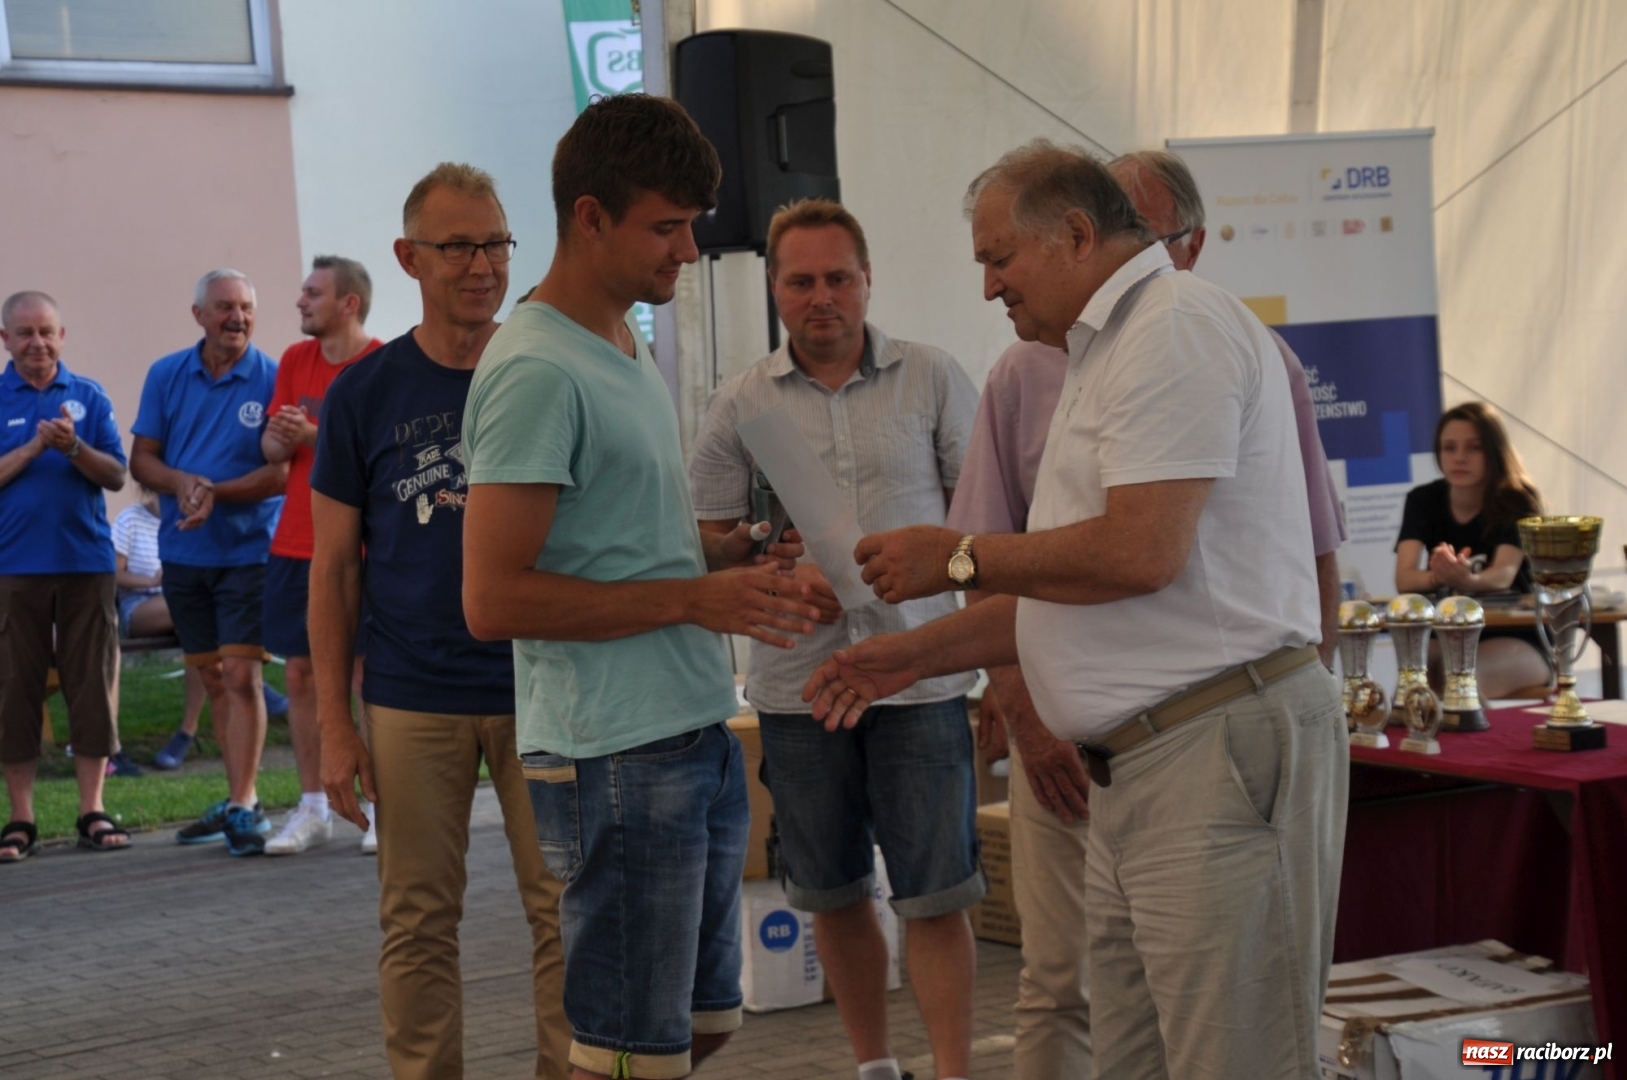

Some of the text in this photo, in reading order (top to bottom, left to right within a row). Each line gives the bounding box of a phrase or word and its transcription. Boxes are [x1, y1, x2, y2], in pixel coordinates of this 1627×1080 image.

[1346, 165, 1391, 189] DRB
[396, 463, 451, 502] GENUINE
[766, 924, 792, 940] RB
